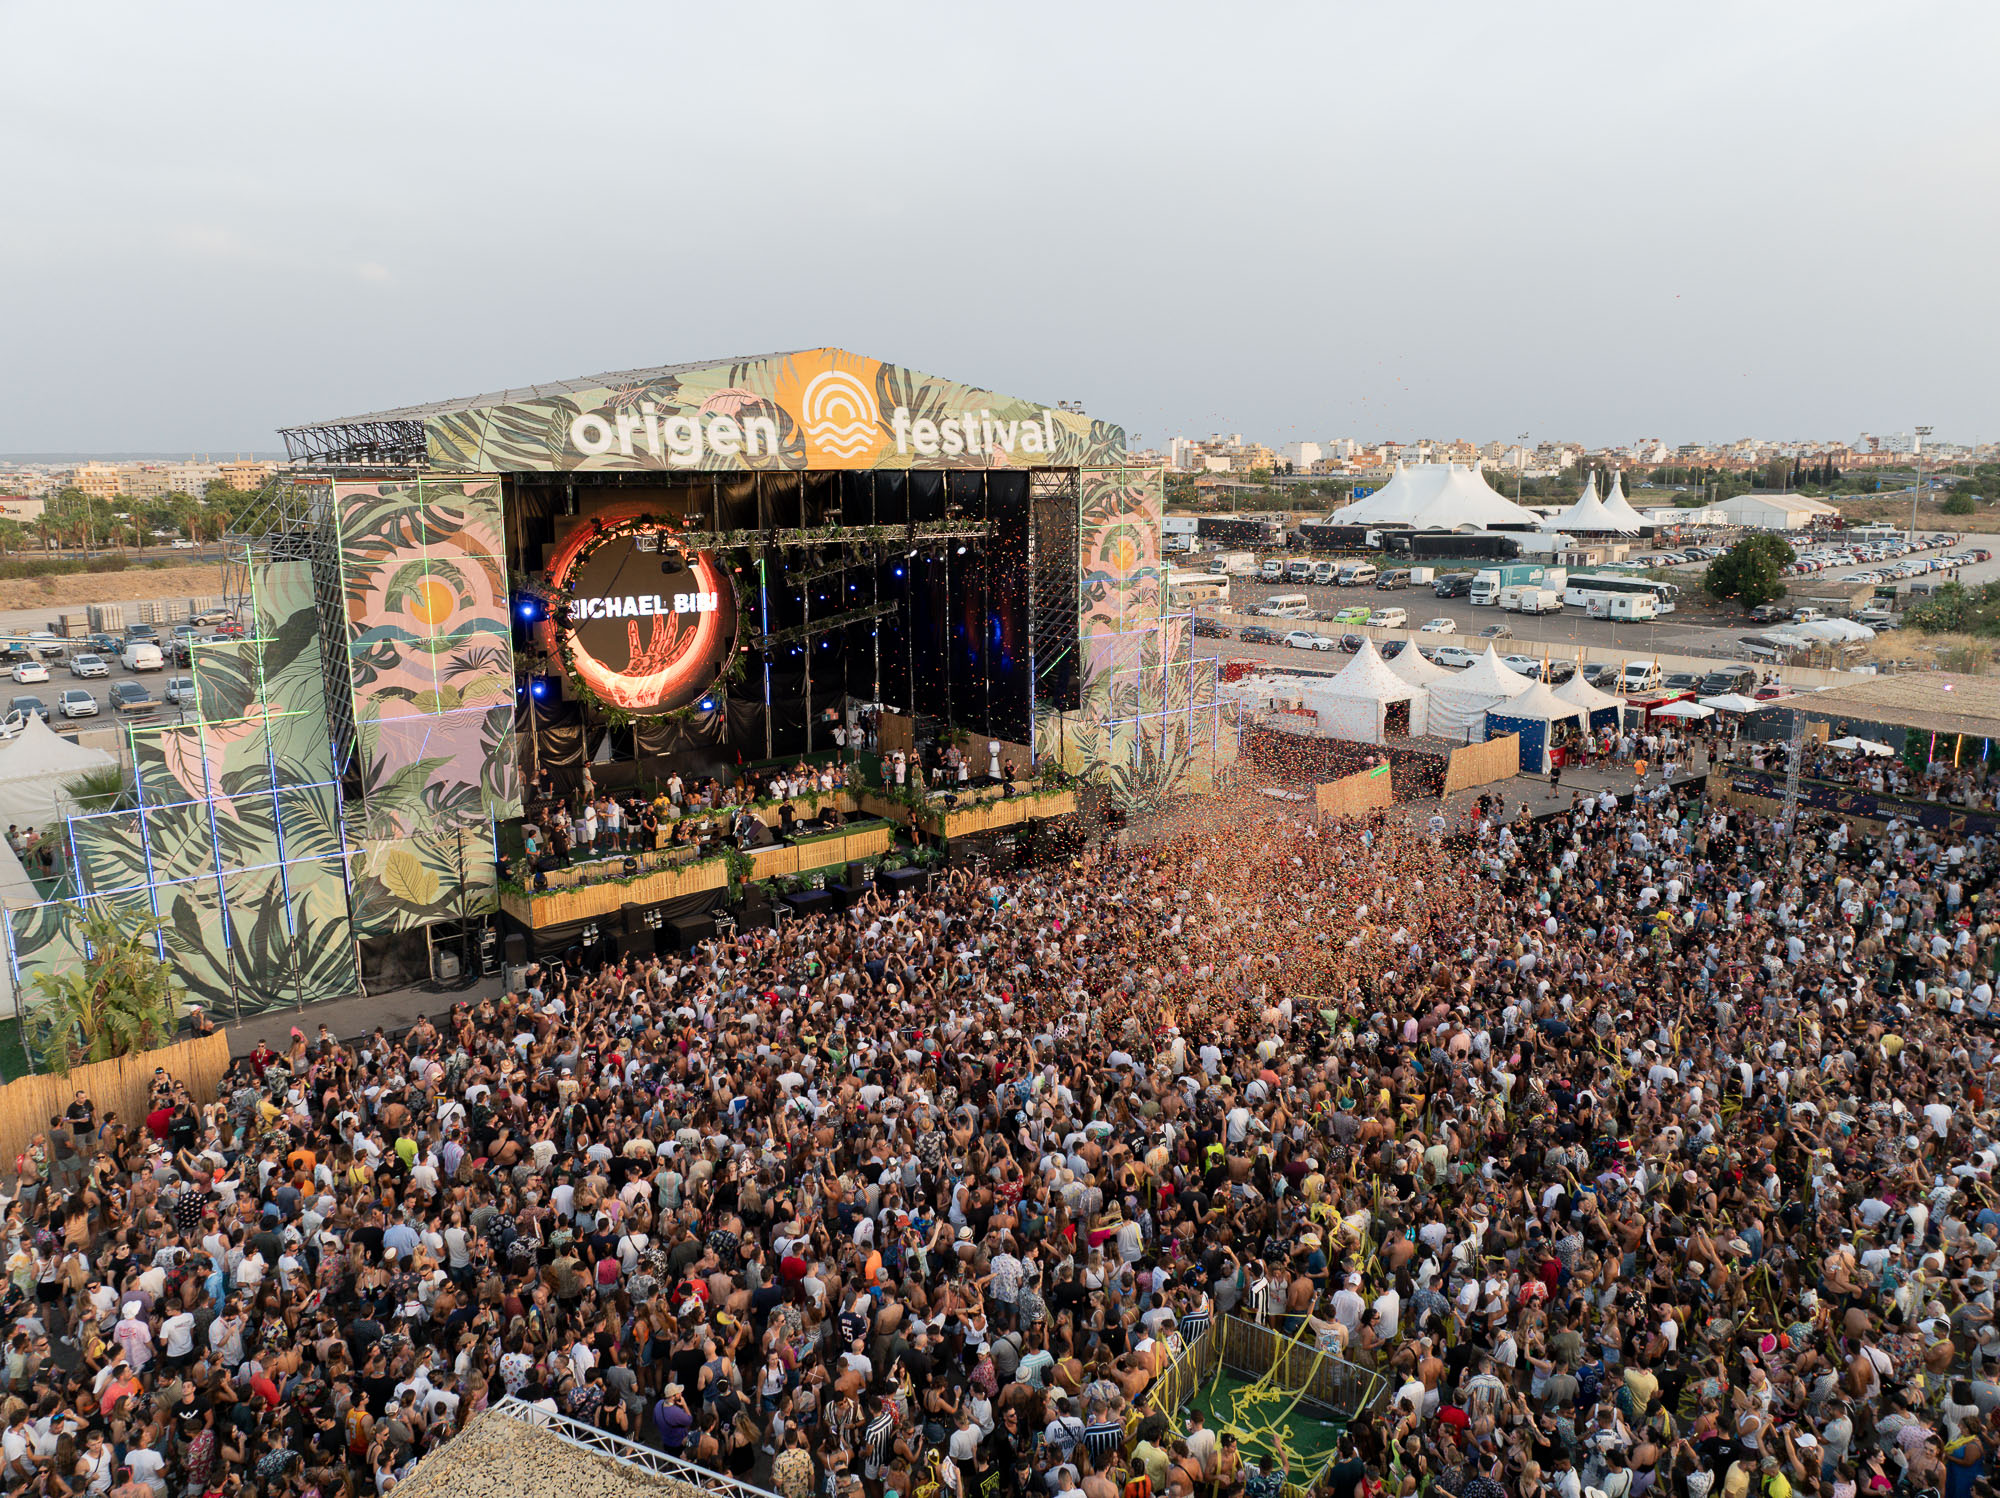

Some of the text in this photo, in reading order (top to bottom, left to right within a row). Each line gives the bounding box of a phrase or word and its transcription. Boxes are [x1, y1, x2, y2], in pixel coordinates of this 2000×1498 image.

[570, 402, 1056, 465] origen festival
[674, 592, 717, 613] BIBI
[1877, 801, 1914, 815] BRUGAL
